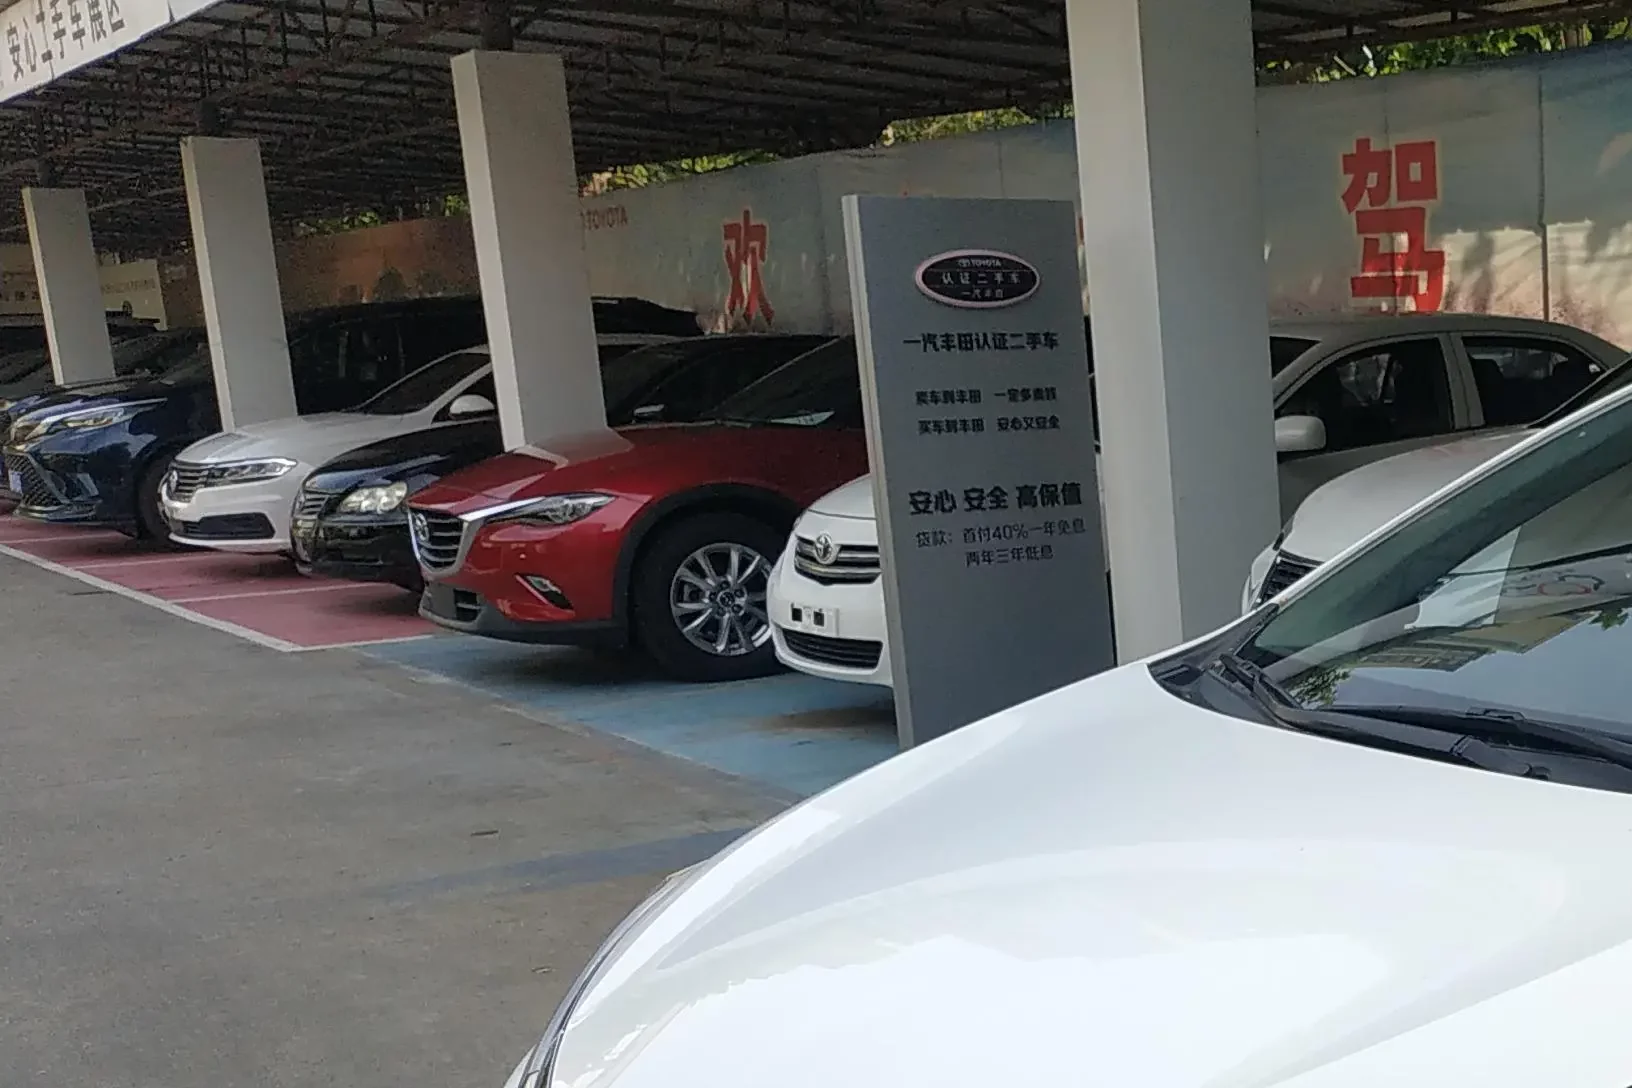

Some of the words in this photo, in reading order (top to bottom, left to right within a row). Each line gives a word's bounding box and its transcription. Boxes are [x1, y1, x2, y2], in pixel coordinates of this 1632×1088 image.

[722, 208, 775, 327] 欢
[902, 331, 1060, 353] 一汽丰田认证二手车
[908, 488, 958, 516] 安心
[963, 485, 1010, 513] 安全
[1015, 481, 1083, 509] 高保值
